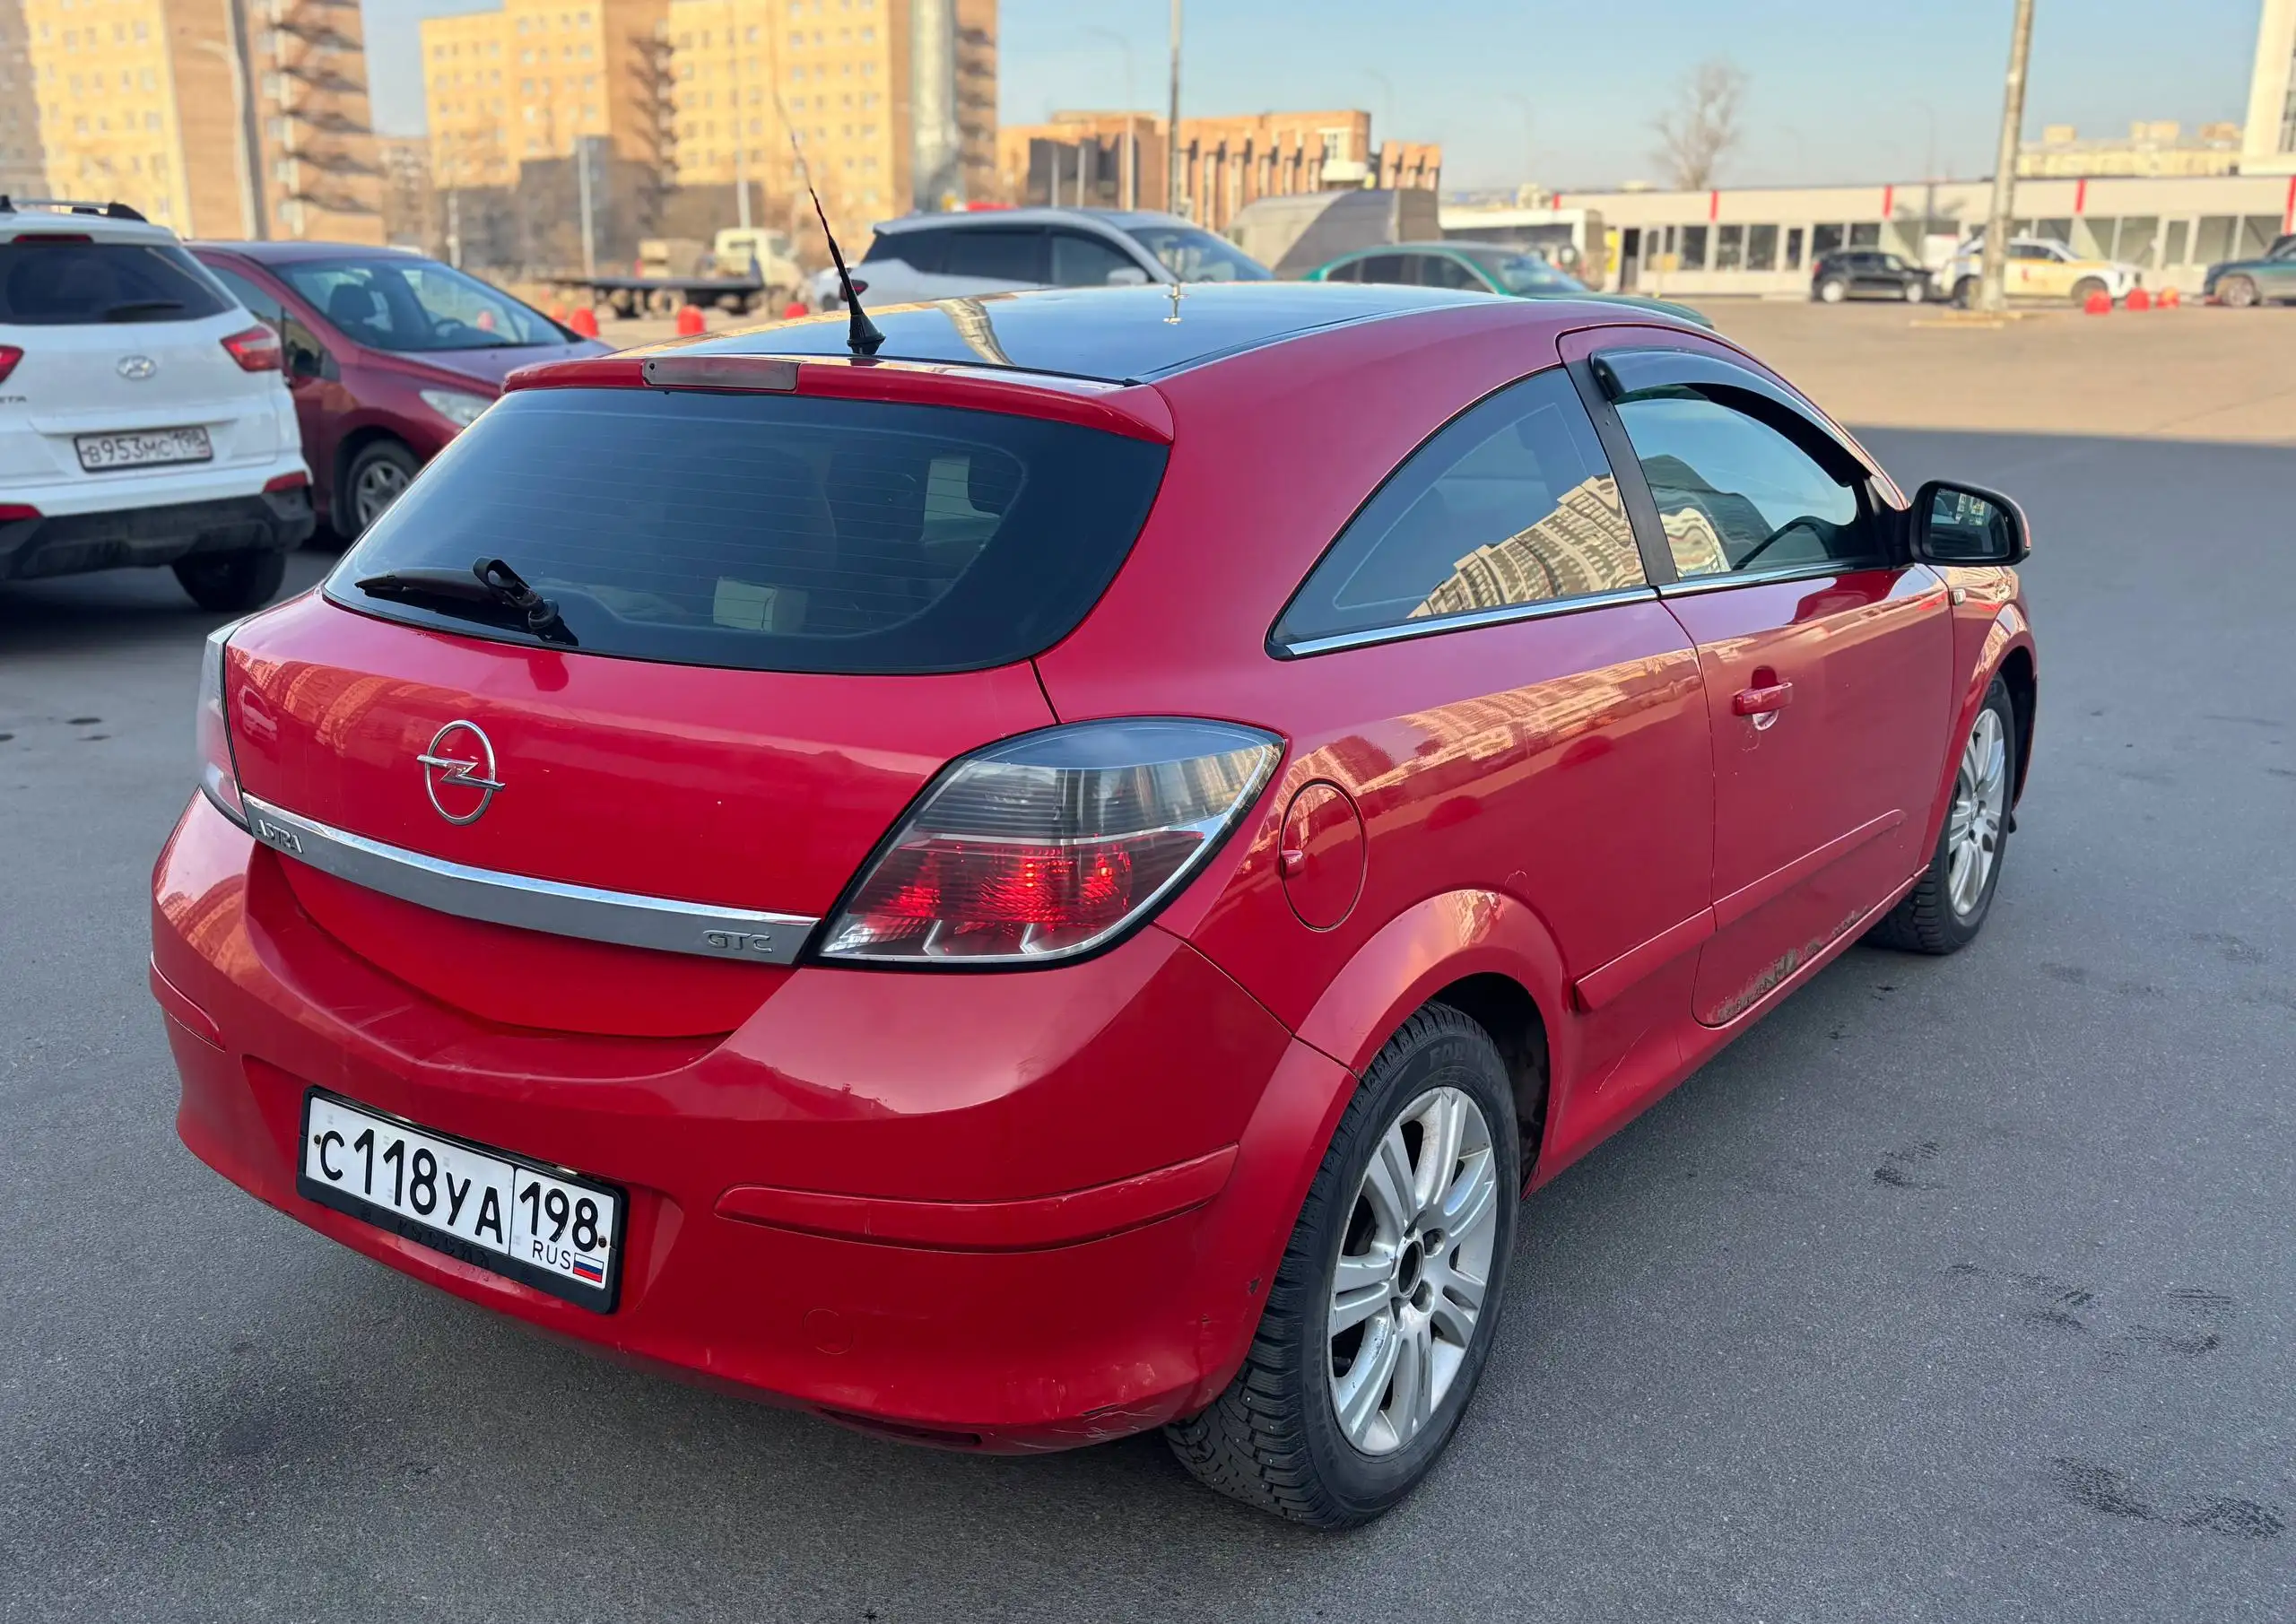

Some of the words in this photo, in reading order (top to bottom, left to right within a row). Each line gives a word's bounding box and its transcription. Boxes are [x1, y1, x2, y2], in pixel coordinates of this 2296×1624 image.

[257, 818, 303, 854] ASTRA
[702, 929, 773, 954] GTC
[518, 1181, 599, 1253] 198
[532, 1241, 571, 1271] RUS
